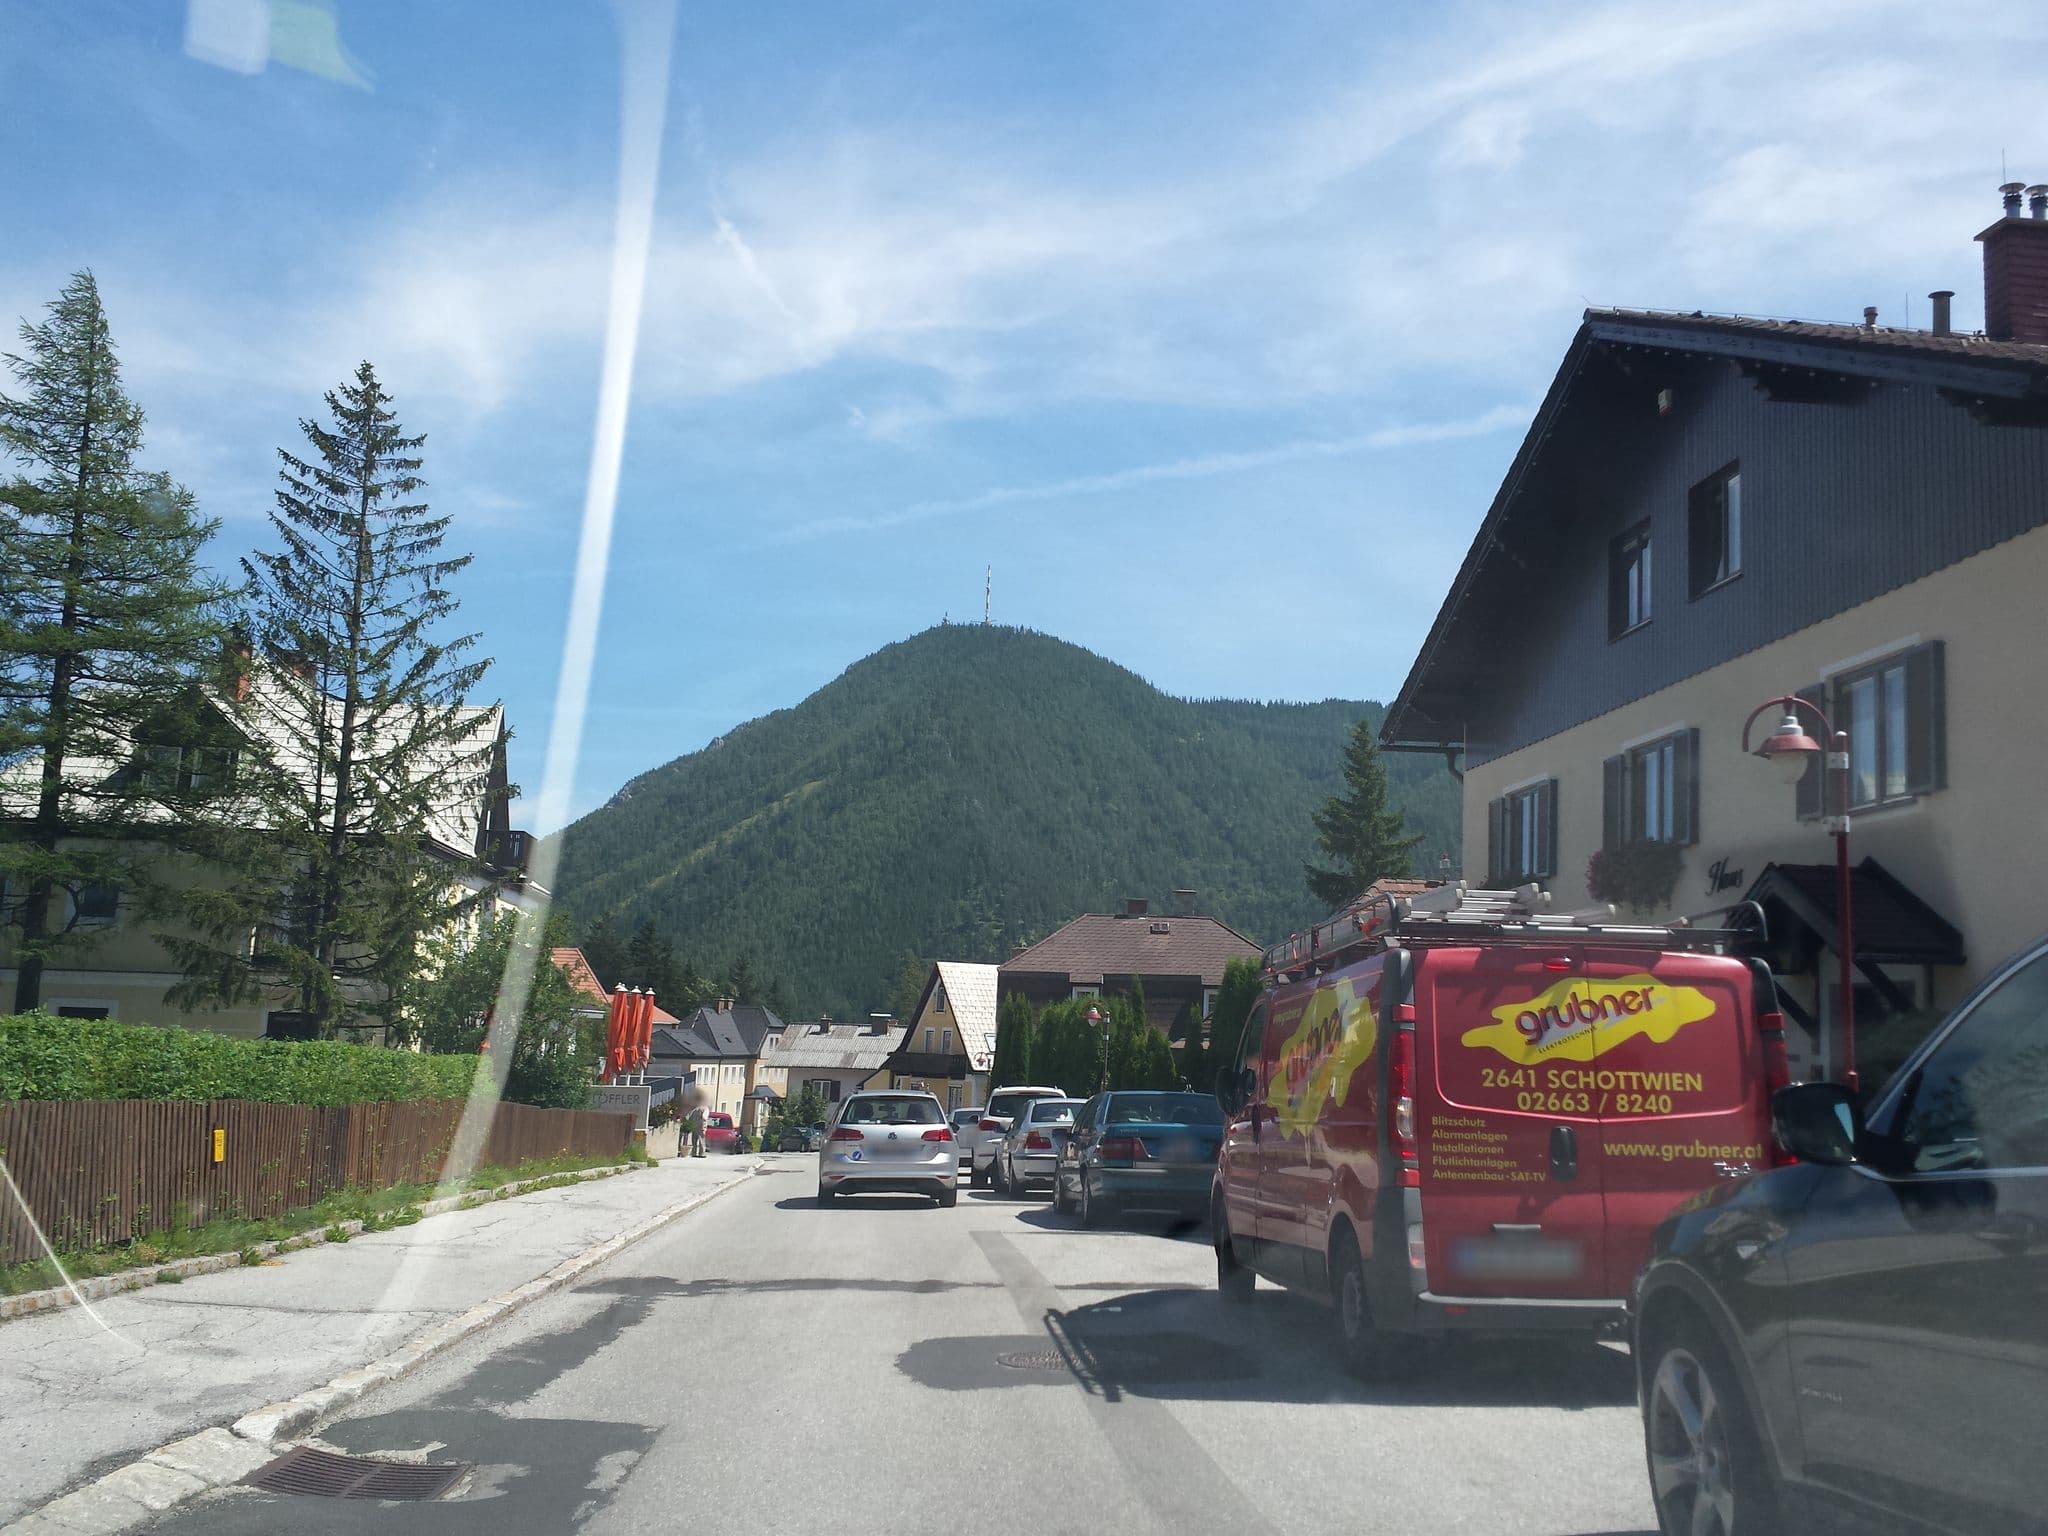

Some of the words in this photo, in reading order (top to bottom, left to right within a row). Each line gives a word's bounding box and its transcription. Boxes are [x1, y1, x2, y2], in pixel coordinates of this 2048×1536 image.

[1515, 986, 1655, 1046] grubner
[1481, 1068, 1537, 1088] 2641
[1547, 1069, 1703, 1092] SCHOTTWIEN
[1517, 1091, 1590, 1111] 02663
[1616, 1093, 1673, 1114] 8240
[1431, 1116, 1487, 1127] Blitzschutz
[1431, 1129, 1508, 1142] Alarmanlagen
[1432, 1142, 1505, 1154] Installationen
[1432, 1156, 1517, 1169] Flutlichtanlagen
[1432, 1169, 1505, 1181] Antennenbau
[1511, 1171, 1547, 1182] SAT-TV
